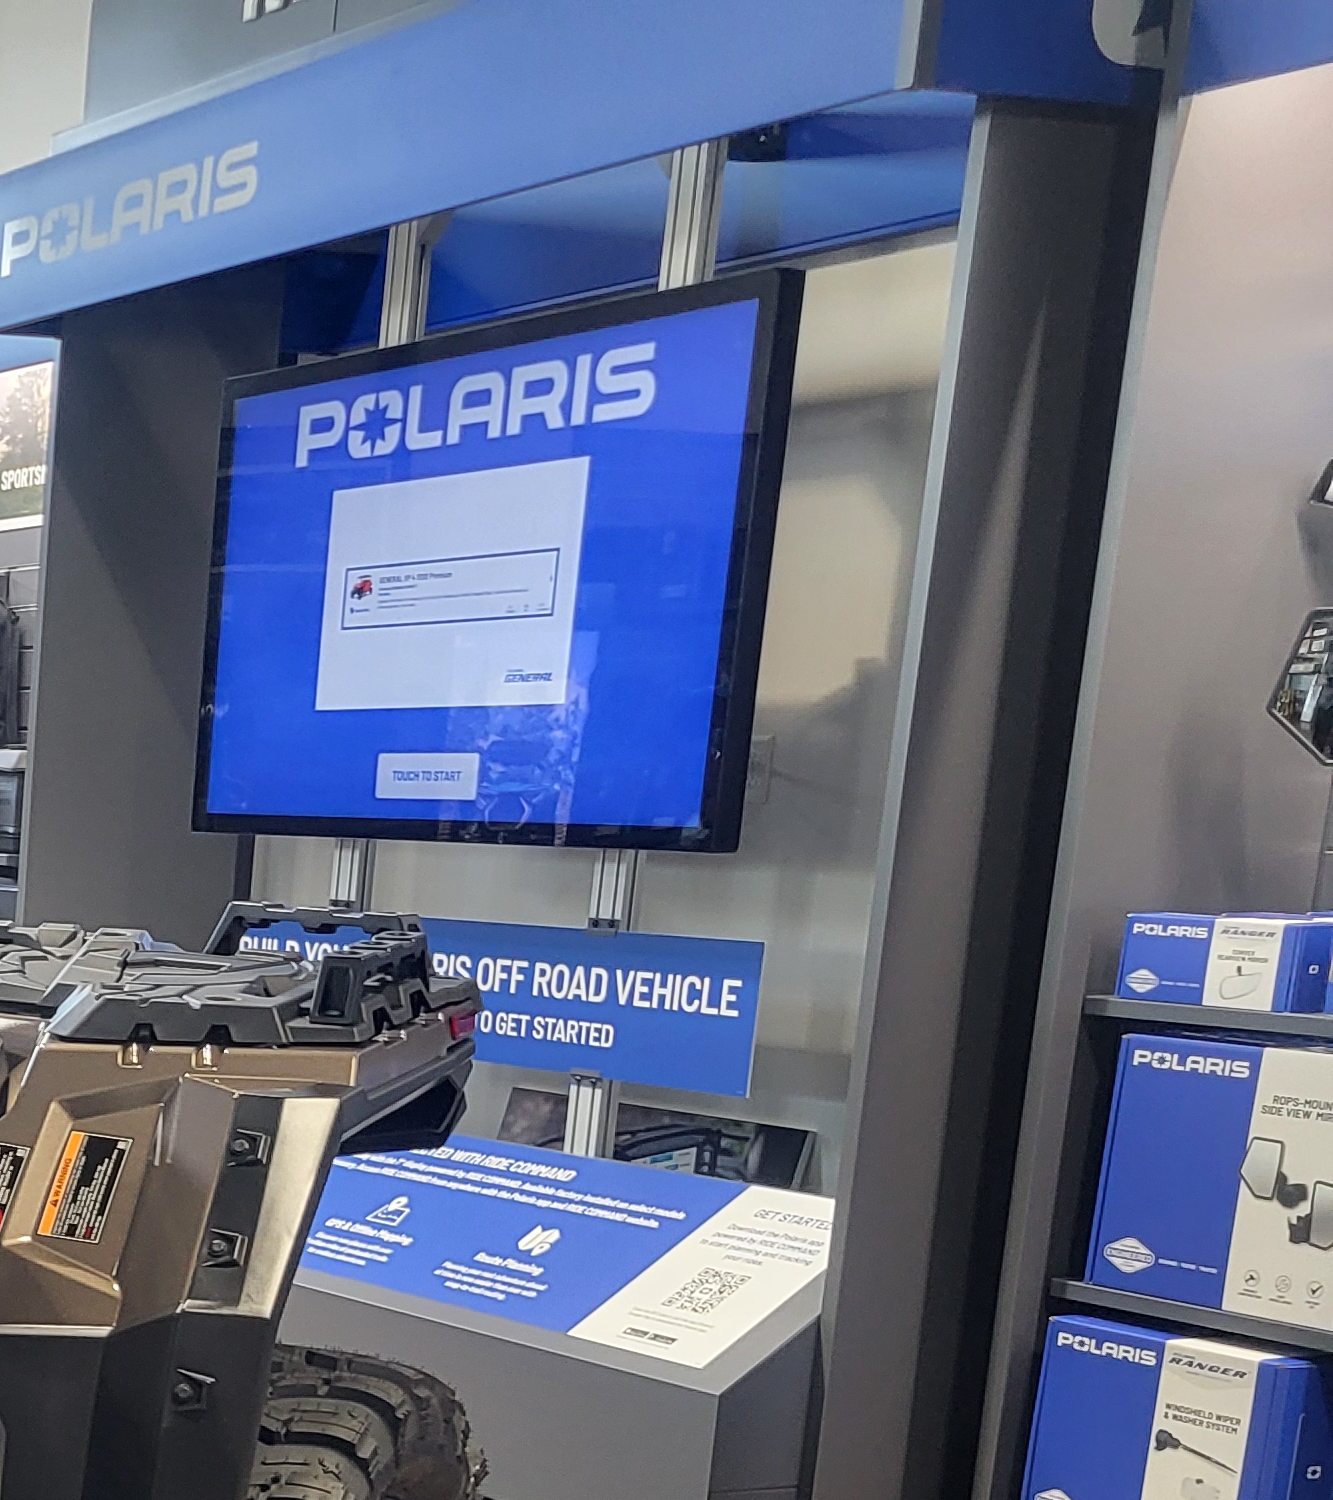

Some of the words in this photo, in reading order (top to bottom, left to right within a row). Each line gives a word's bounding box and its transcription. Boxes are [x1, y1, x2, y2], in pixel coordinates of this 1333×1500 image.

[0, 140, 259, 279] POLARIS
[294, 341, 658, 469] POLARIS
[504, 672, 553, 683] GENERAL
[392, 769, 420, 782] TOUCH
[421, 770, 432, 782] TO
[433, 770, 462, 782] START
[1132, 922, 1208, 939] POLARIS
[1220, 928, 1277, 939] RANGER
[477, 958, 529, 994] OFF
[533, 963, 609, 1004] ROAD
[616, 969, 744, 1018] VEHICLE
[495, 1014, 530, 1039] GET
[532, 1017, 615, 1049] STARTED
[1132, 1049, 1250, 1078] POLARIS
[1260, 1104, 1284, 1117] SIDE
[1286, 1107, 1313, 1120] VIEW
[53, 1157, 73, 1199] WARNING
[509, 1159, 578, 1182] COMMAND
[753, 1208, 782, 1221] GET
[1056, 1331, 1158, 1366] POLARIS
[1167, 1356, 1249, 1380] RANGER
[1163, 1410, 1170, 1419] &
[1171, 1412, 1205, 1427] WASHER
[1205, 1421, 1238, 1436] SYSTEM
[1164, 1402, 1214, 1420] WINDSHIELD
[1214, 1414, 1241, 1426] WIPER
